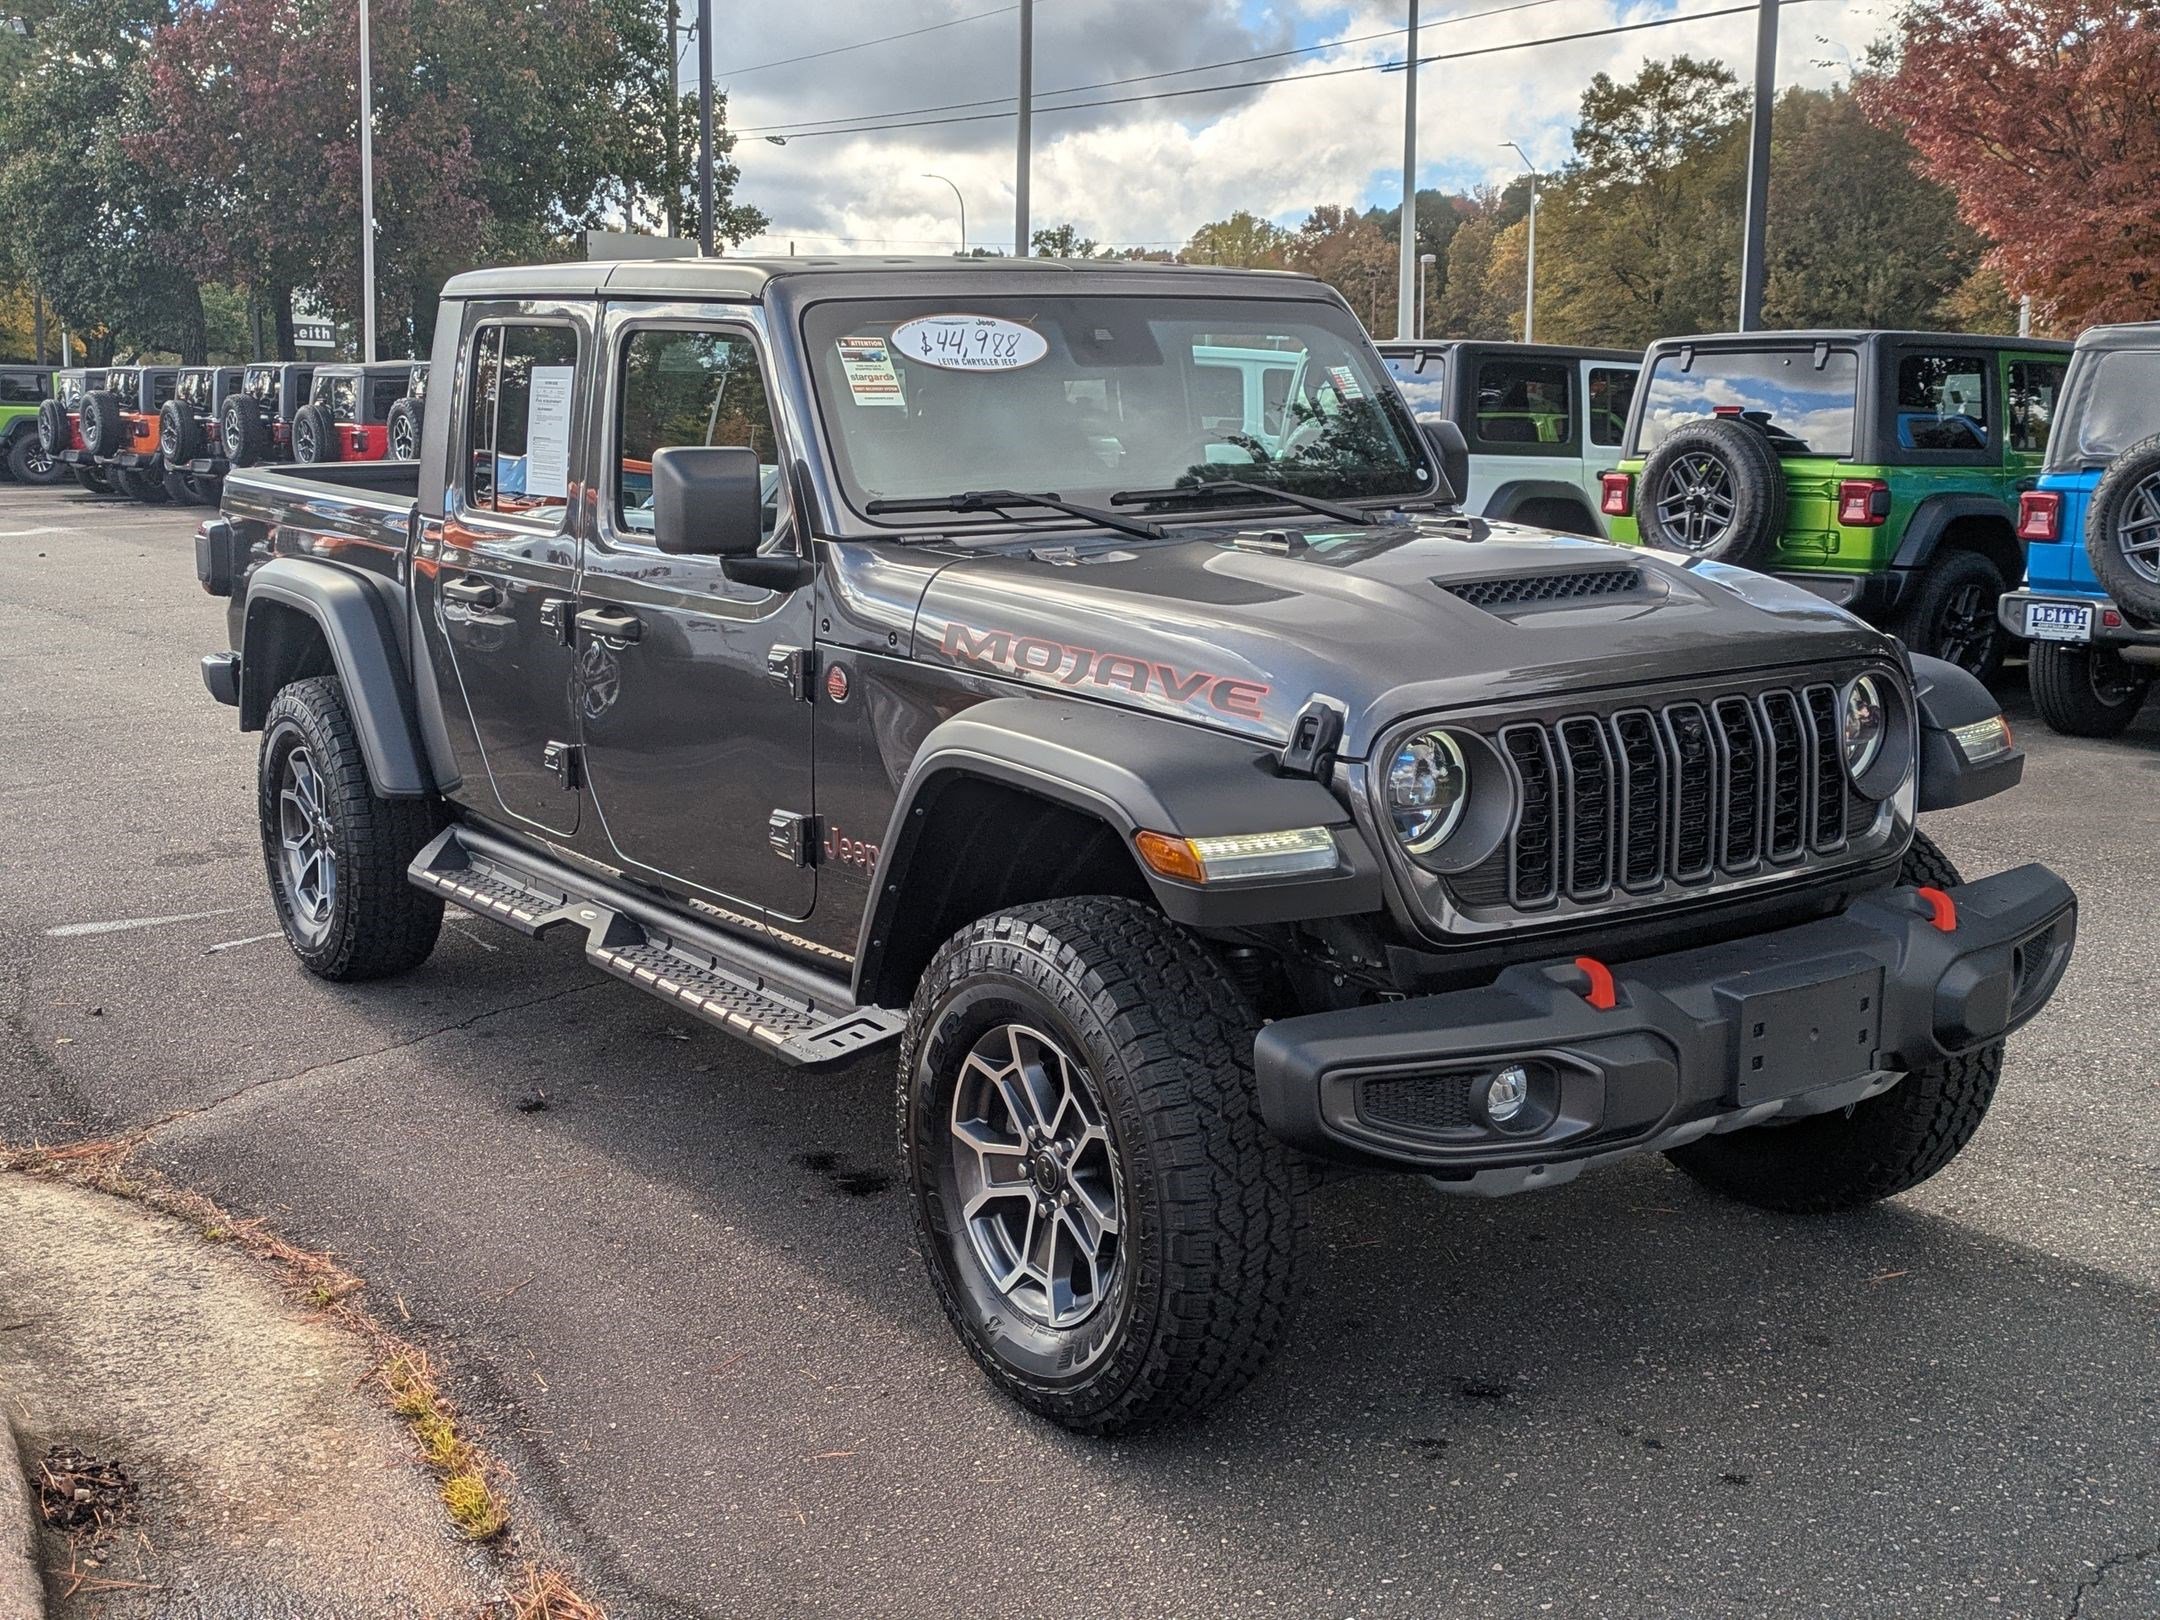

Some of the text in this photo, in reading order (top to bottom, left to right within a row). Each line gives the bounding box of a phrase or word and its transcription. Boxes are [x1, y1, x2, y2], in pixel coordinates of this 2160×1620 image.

[976, 319, 996, 327] Jeep
[920, 328, 1021, 358] $44,988
[938, 358, 960, 366] LEITH
[962, 358, 999, 366] CHRYSLER
[2032, 607, 2088, 625] LEITH
[940, 622, 1272, 720] MOJAVE
[823, 826, 880, 876] Jeep
